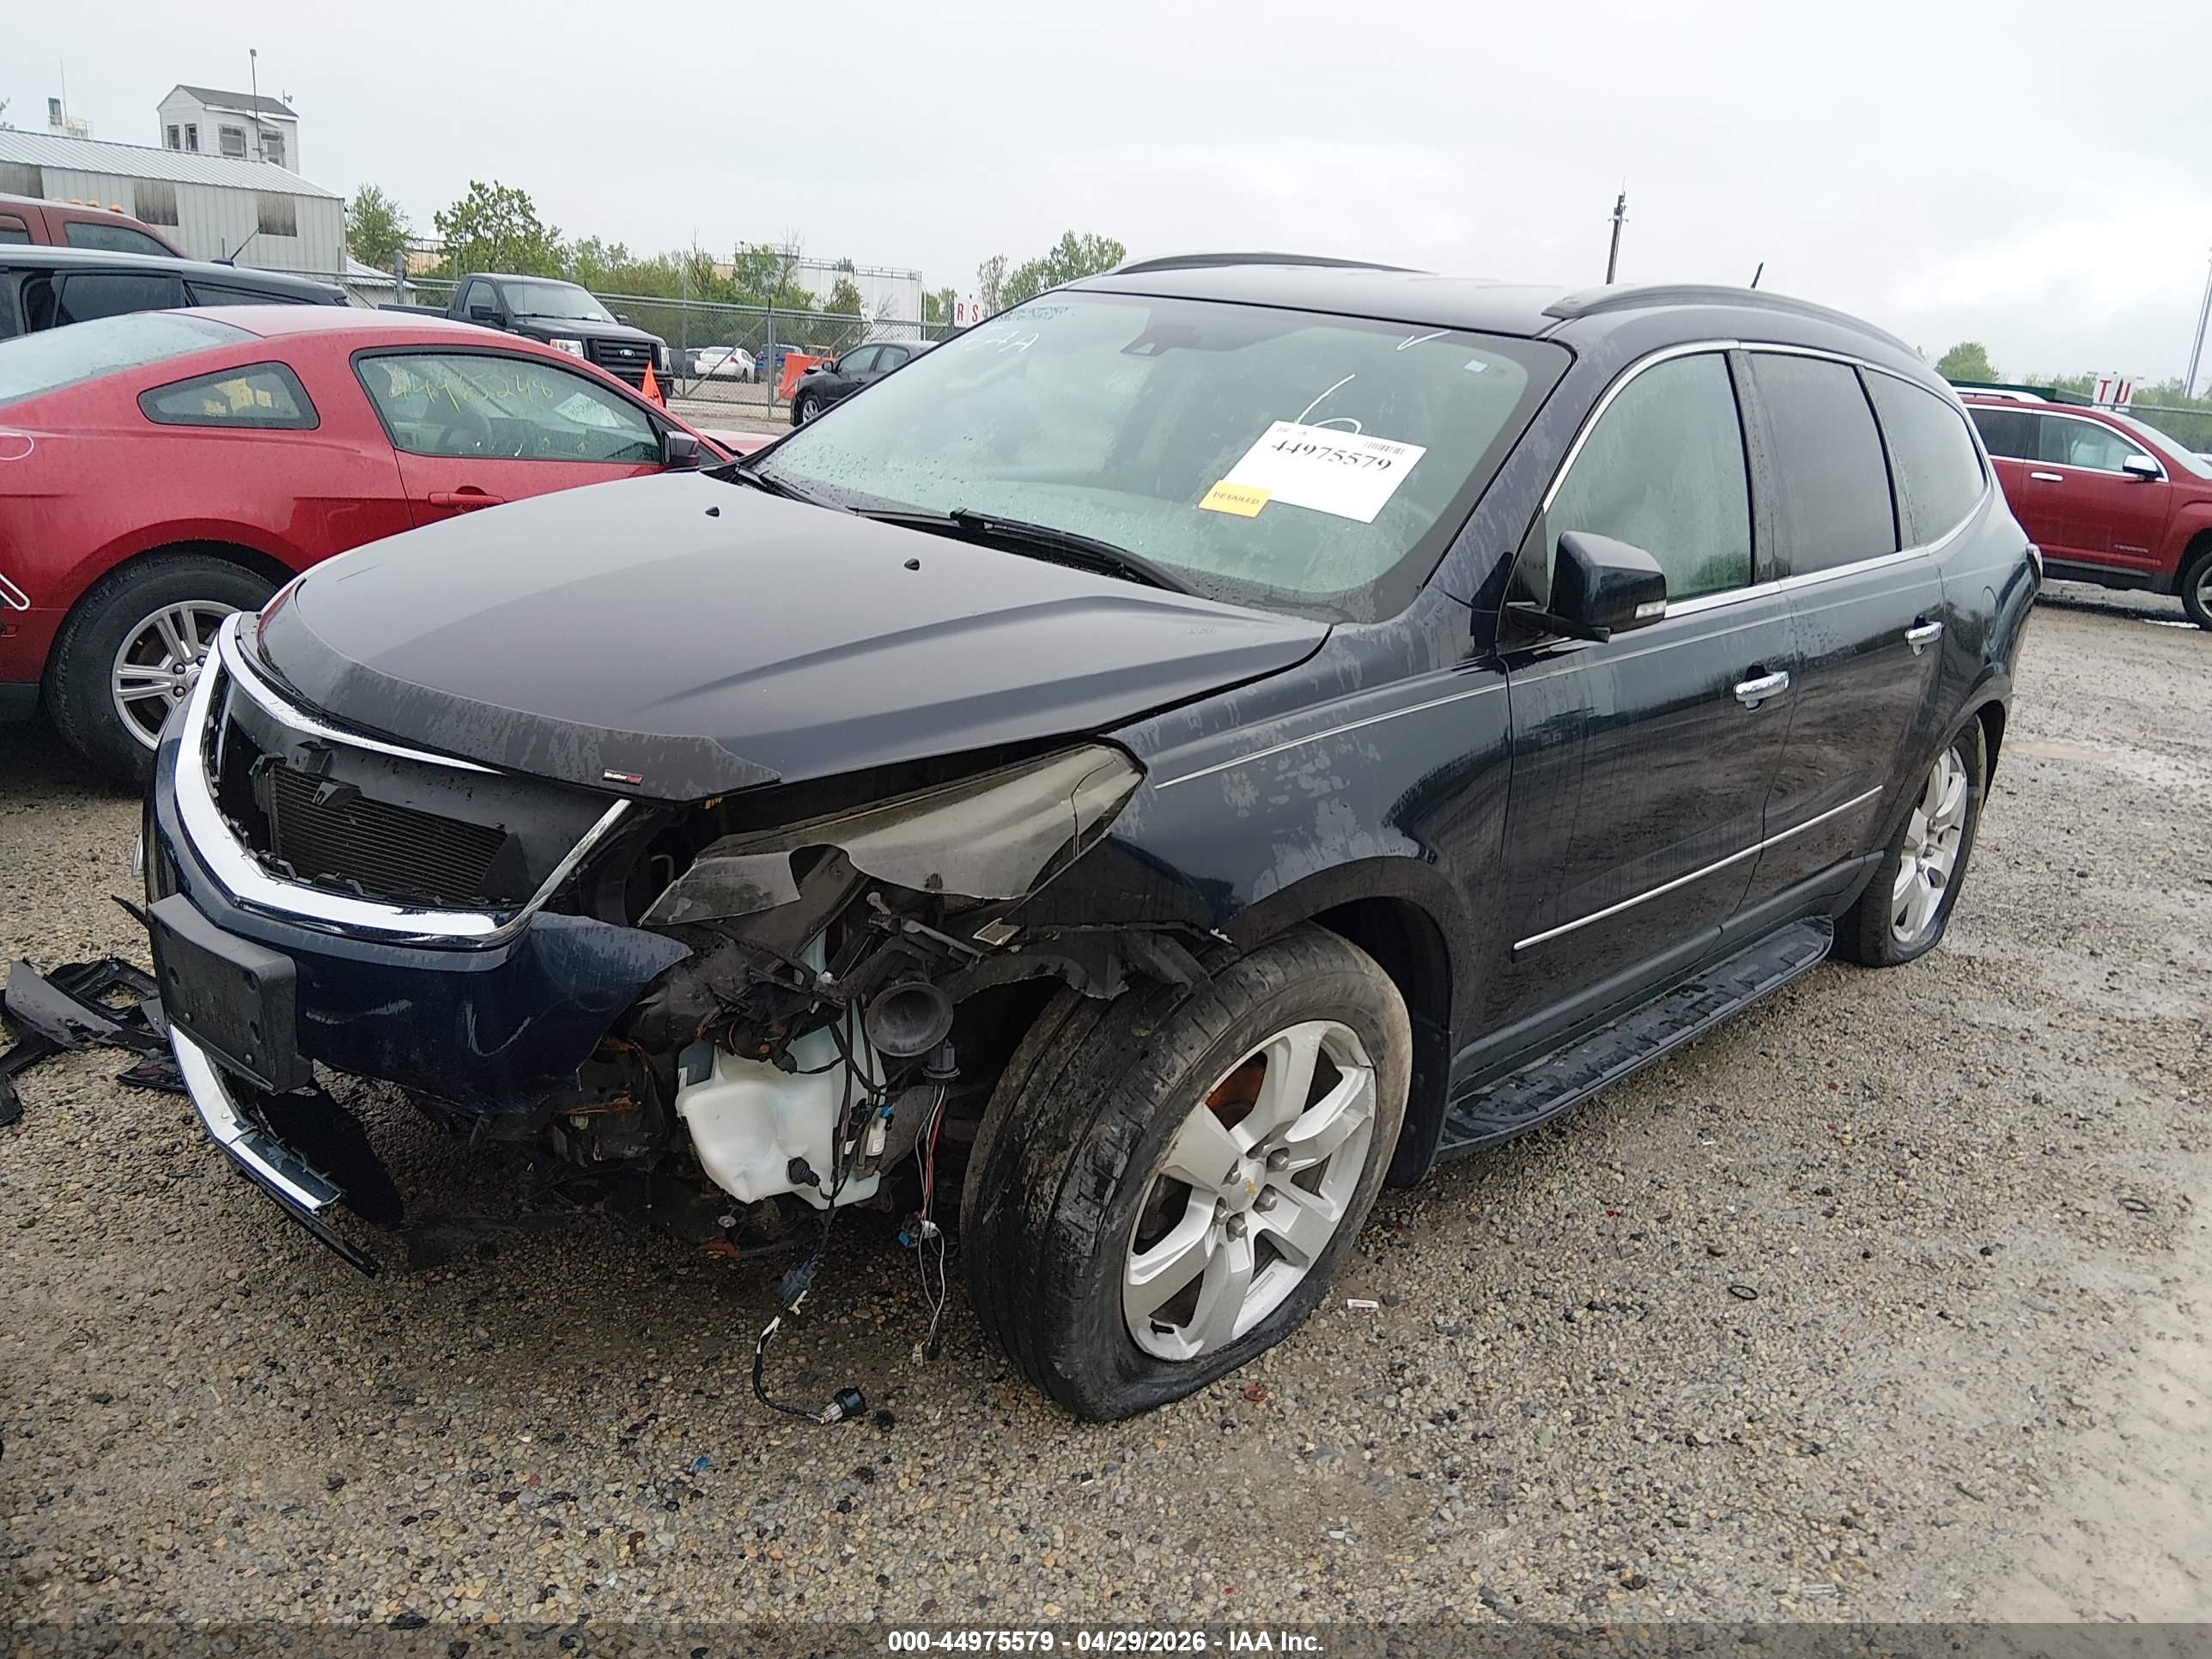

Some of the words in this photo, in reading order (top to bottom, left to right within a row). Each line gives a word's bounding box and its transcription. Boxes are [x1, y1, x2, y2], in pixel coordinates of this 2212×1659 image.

[957, 302, 964, 322] R
[971, 303, 979, 323] S
[2098, 379, 2112, 404] T
[2114, 380, 2131, 404] U
[1270, 439, 1393, 471] 44975579
[1212, 490, 1261, 505] DETAILED
